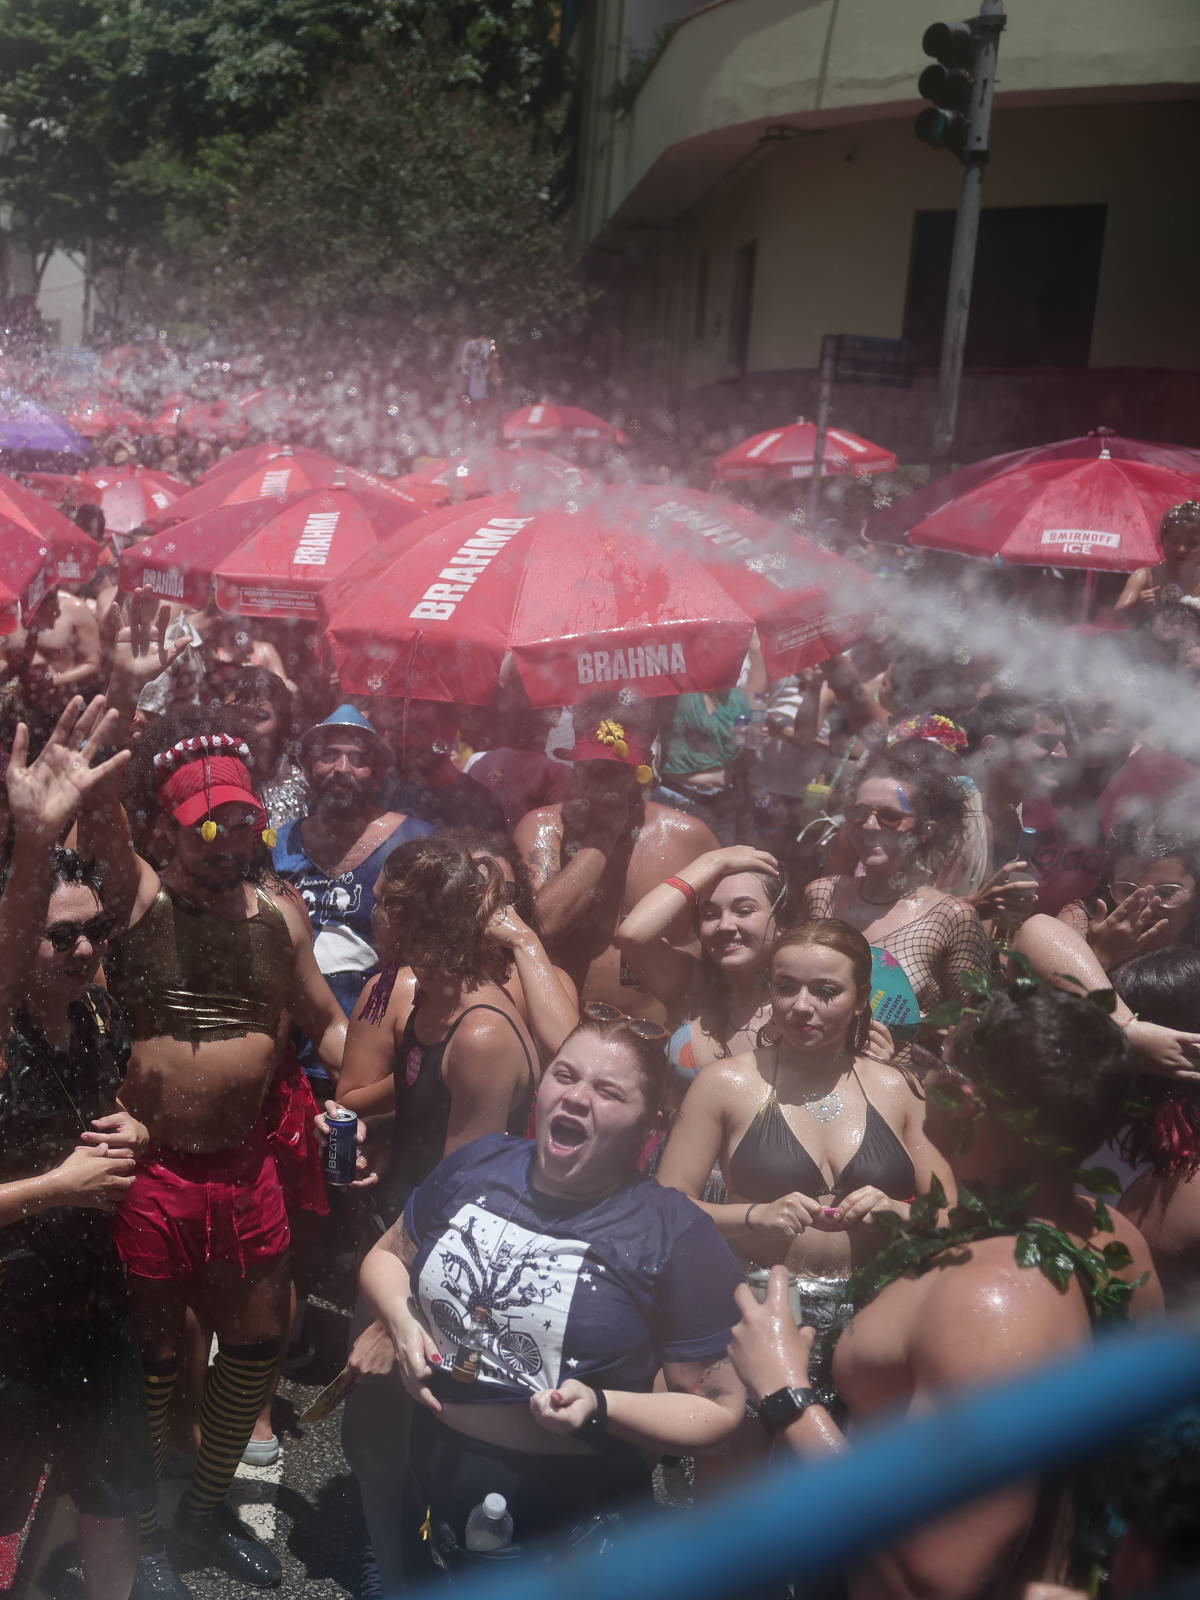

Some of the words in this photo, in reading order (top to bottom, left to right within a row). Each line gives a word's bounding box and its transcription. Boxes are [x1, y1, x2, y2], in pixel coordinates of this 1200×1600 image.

[293, 511, 341, 565] BRAHMA
[1049, 531, 1113, 544] SMIRNOFF
[1062, 543, 1094, 555] ICE
[409, 516, 536, 621] BRAHMA
[577, 643, 687, 685] BRAHMA
[328, 1127, 338, 1169] BEATS
